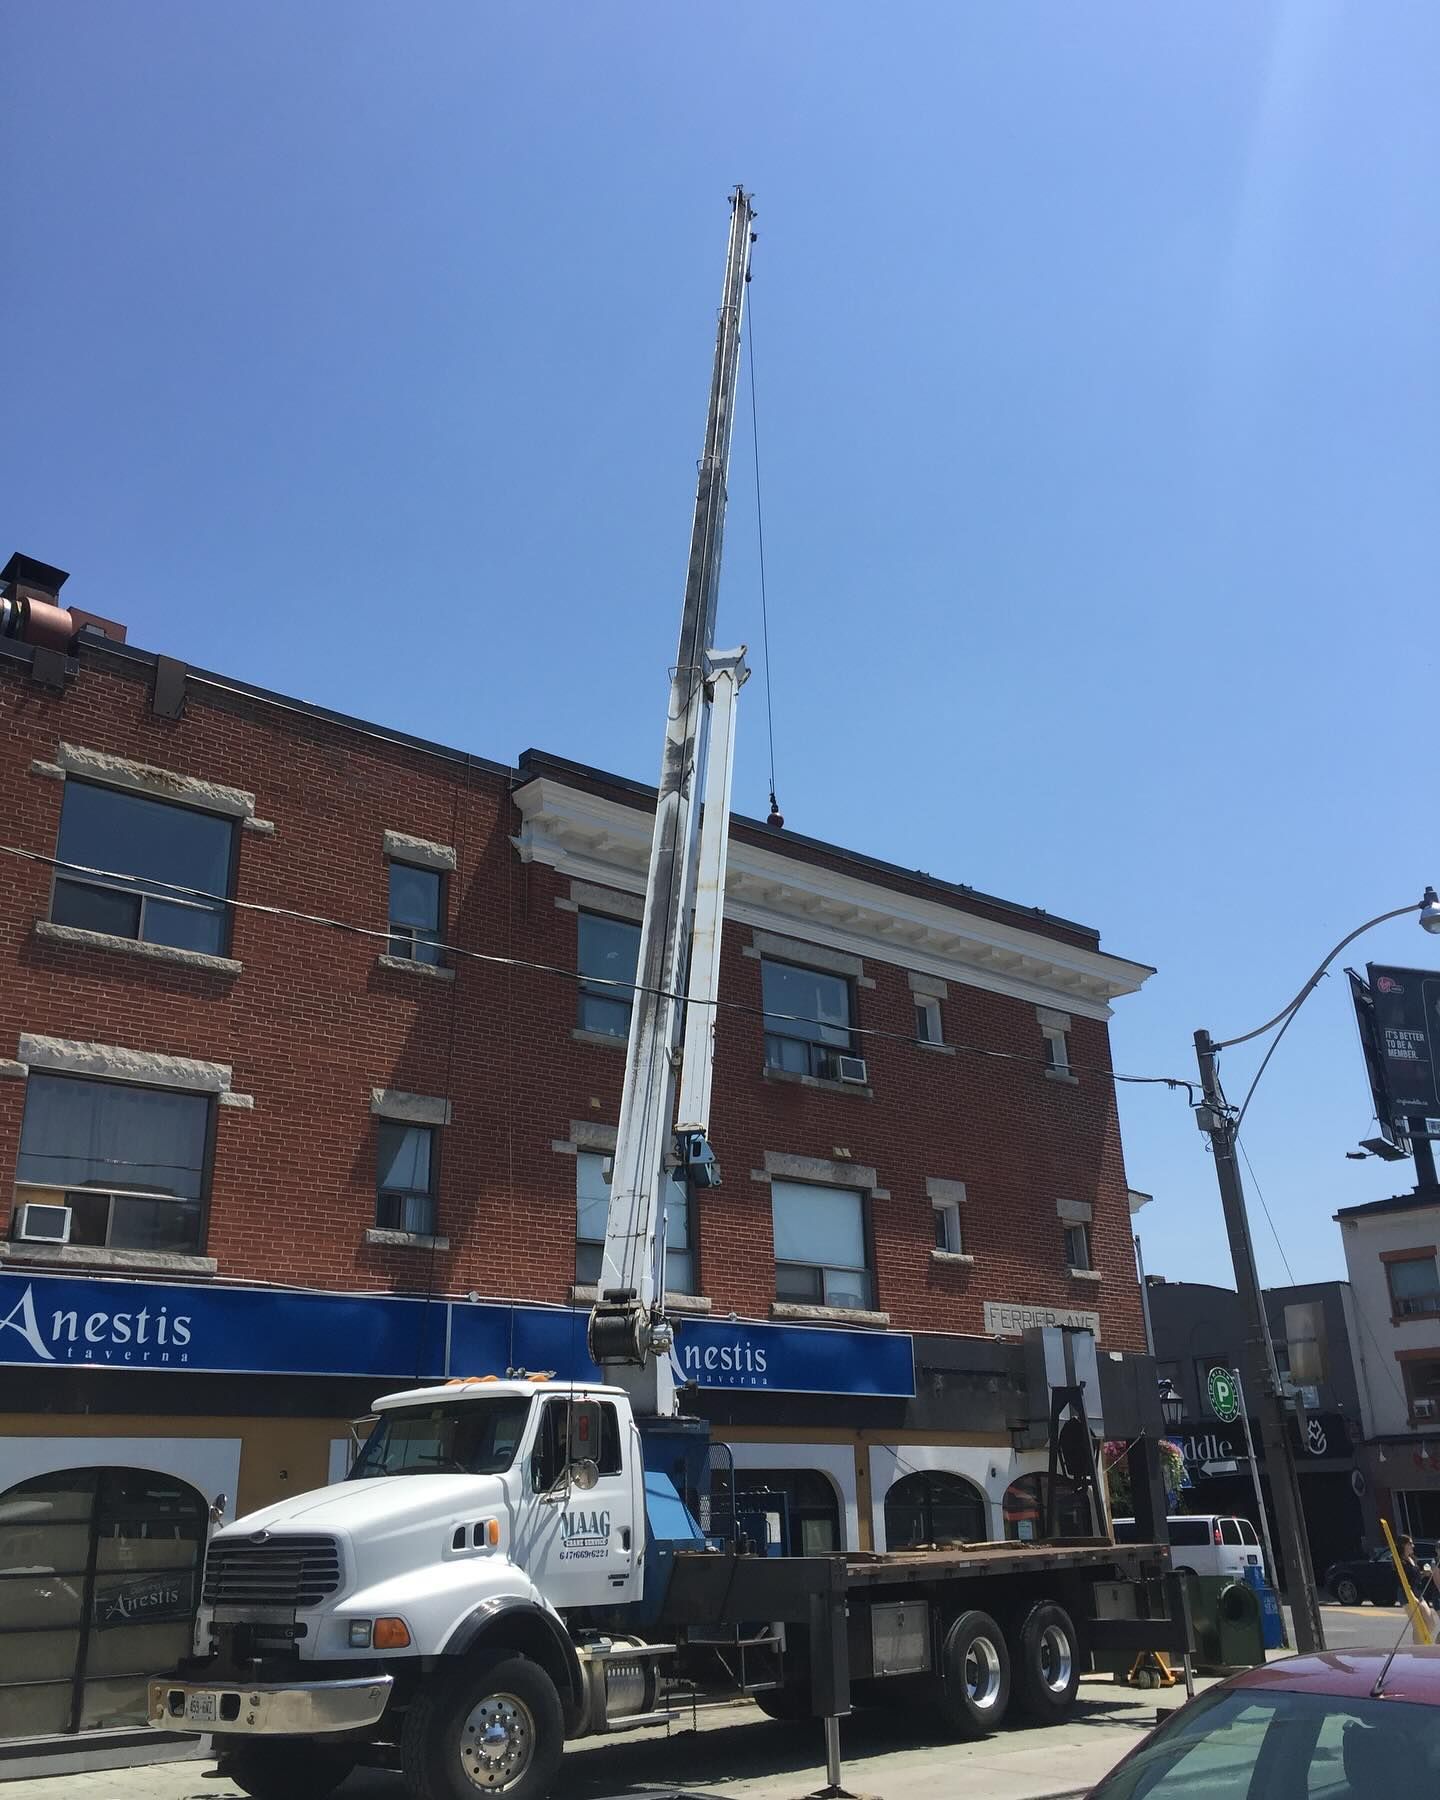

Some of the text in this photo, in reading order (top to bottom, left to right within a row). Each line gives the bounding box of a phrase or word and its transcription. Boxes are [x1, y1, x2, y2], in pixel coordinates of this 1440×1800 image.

[1385, 1030, 1425, 1041] IT'S BETTER
[1386, 1039, 1413, 1049] TO BE A
[0, 1282, 192, 1360] Anestis
[989, 1307, 1056, 1329] FERRIER
[67, 1346, 189, 1362] taverna
[696, 1374, 768, 1385] taverna
[1216, 1381, 1230, 1403] P
[1183, 1434, 1233, 1461] ddle
[560, 1510, 611, 1540] MAAG
[105, 1587, 179, 1620] Anestis
